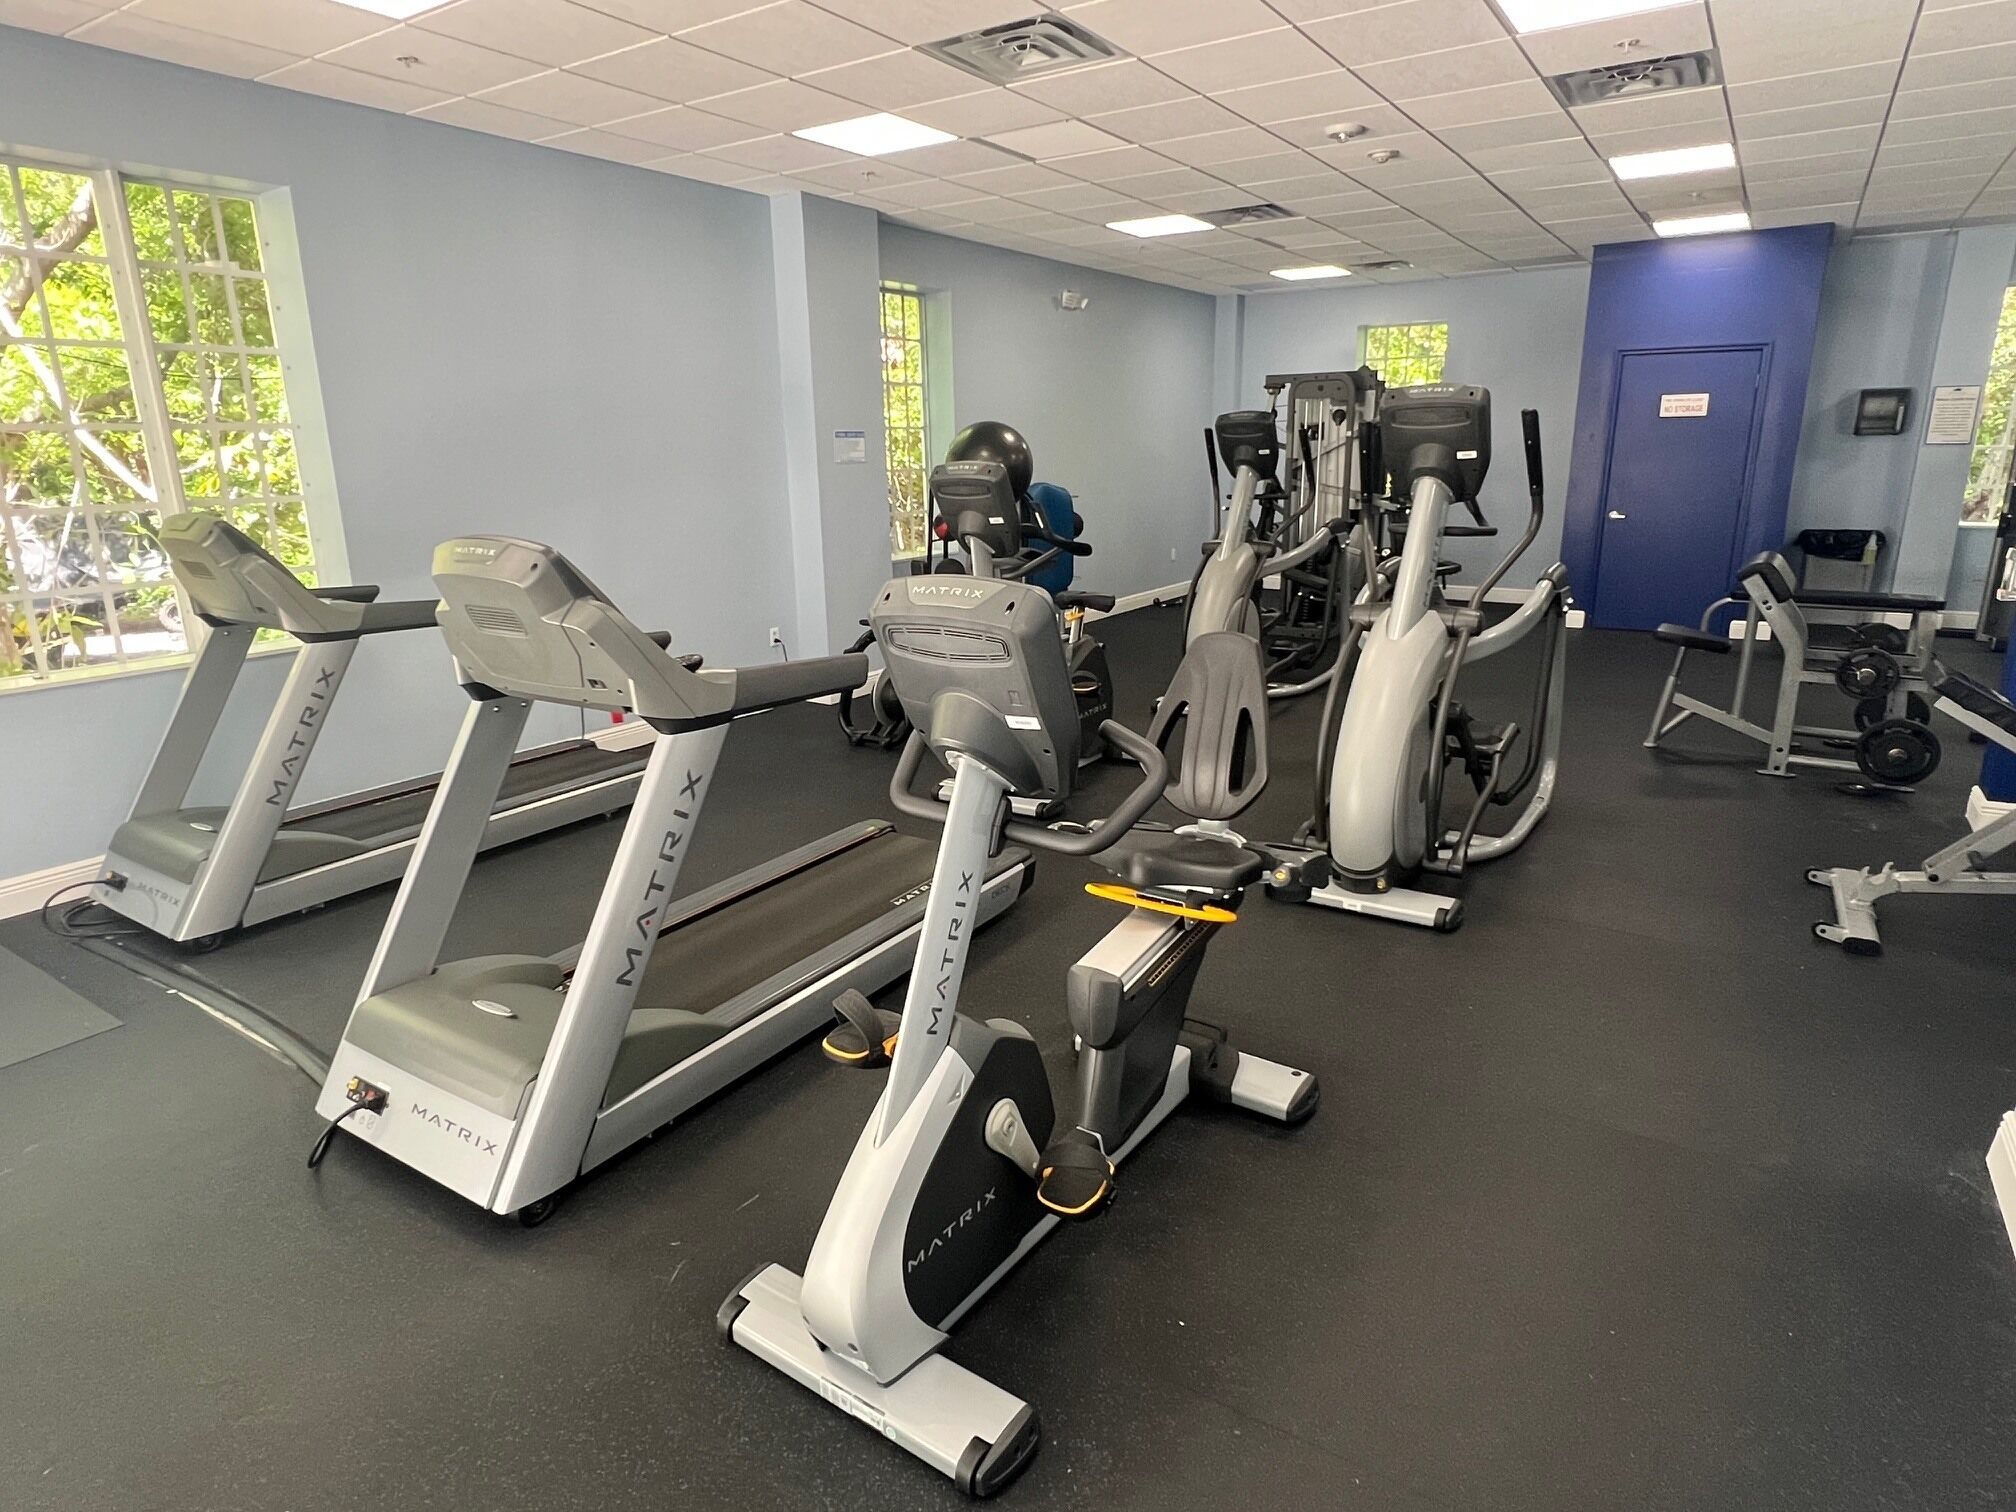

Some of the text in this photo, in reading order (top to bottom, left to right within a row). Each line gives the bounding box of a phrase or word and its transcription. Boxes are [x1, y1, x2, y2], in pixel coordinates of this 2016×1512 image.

[455, 547, 496, 556] MATRIX
[912, 586, 983, 598] MATRIX
[266, 667, 335, 806] MATRIX
[138, 882, 179, 906] MATRIX
[616, 768, 703, 986] MATRIX
[927, 870, 974, 1036] MATRIX
[411, 1103, 498, 1156] MATRIX
[908, 1186, 996, 1273] MATRIX
